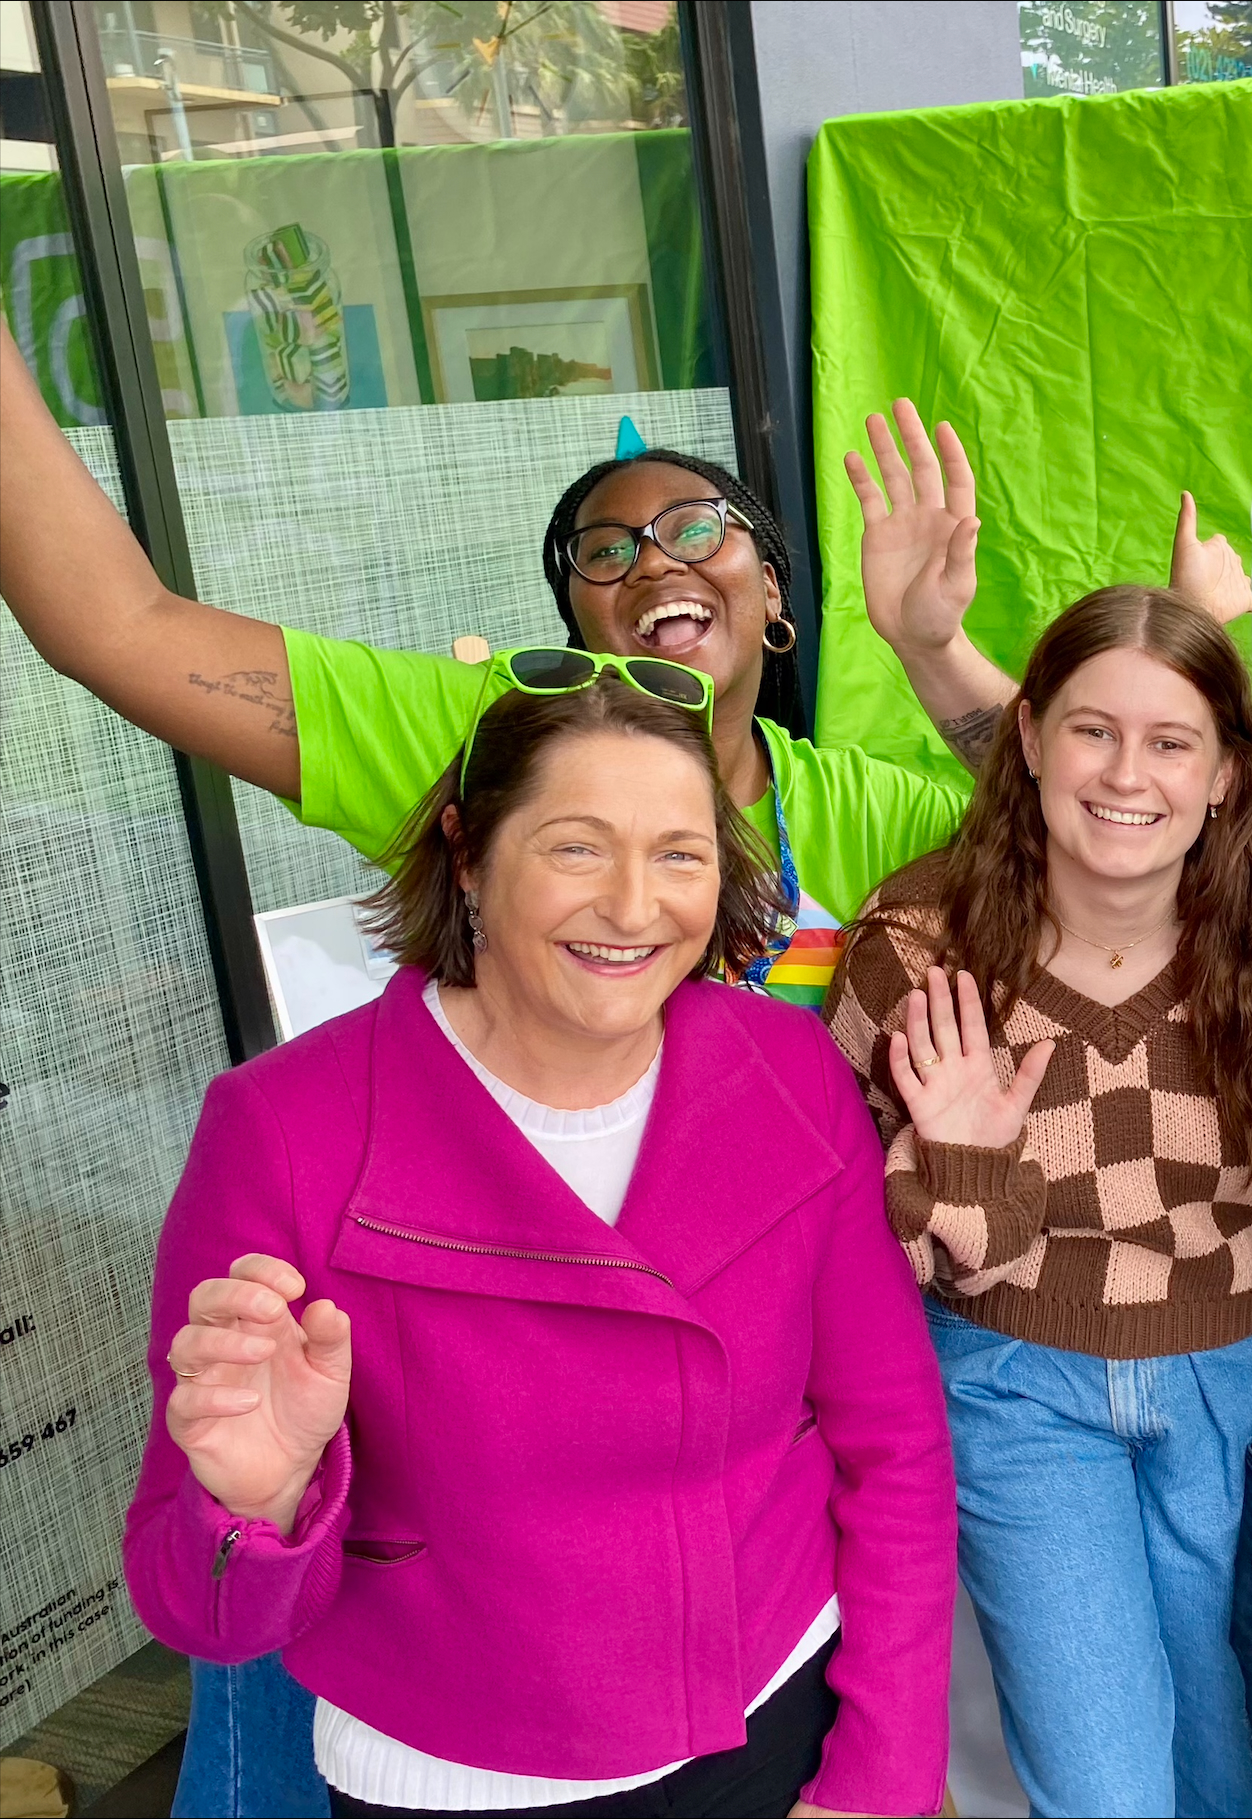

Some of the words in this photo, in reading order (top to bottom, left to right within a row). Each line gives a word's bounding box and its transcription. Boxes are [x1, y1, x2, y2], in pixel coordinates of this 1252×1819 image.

[1042, 3, 1064, 31] and
[1064, 8, 1107, 48] Surgery
[1084, 70, 1118, 94] Health
[41, 1407, 77, 1440] 467
[1, 1588, 77, 1646] Australian
[31, 1625, 46, 1643] of
[48, 1588, 105, 1633] funding
[106, 1577, 119, 1592] is
[31, 1649, 46, 1665] in
[49, 1629, 75, 1652] this
